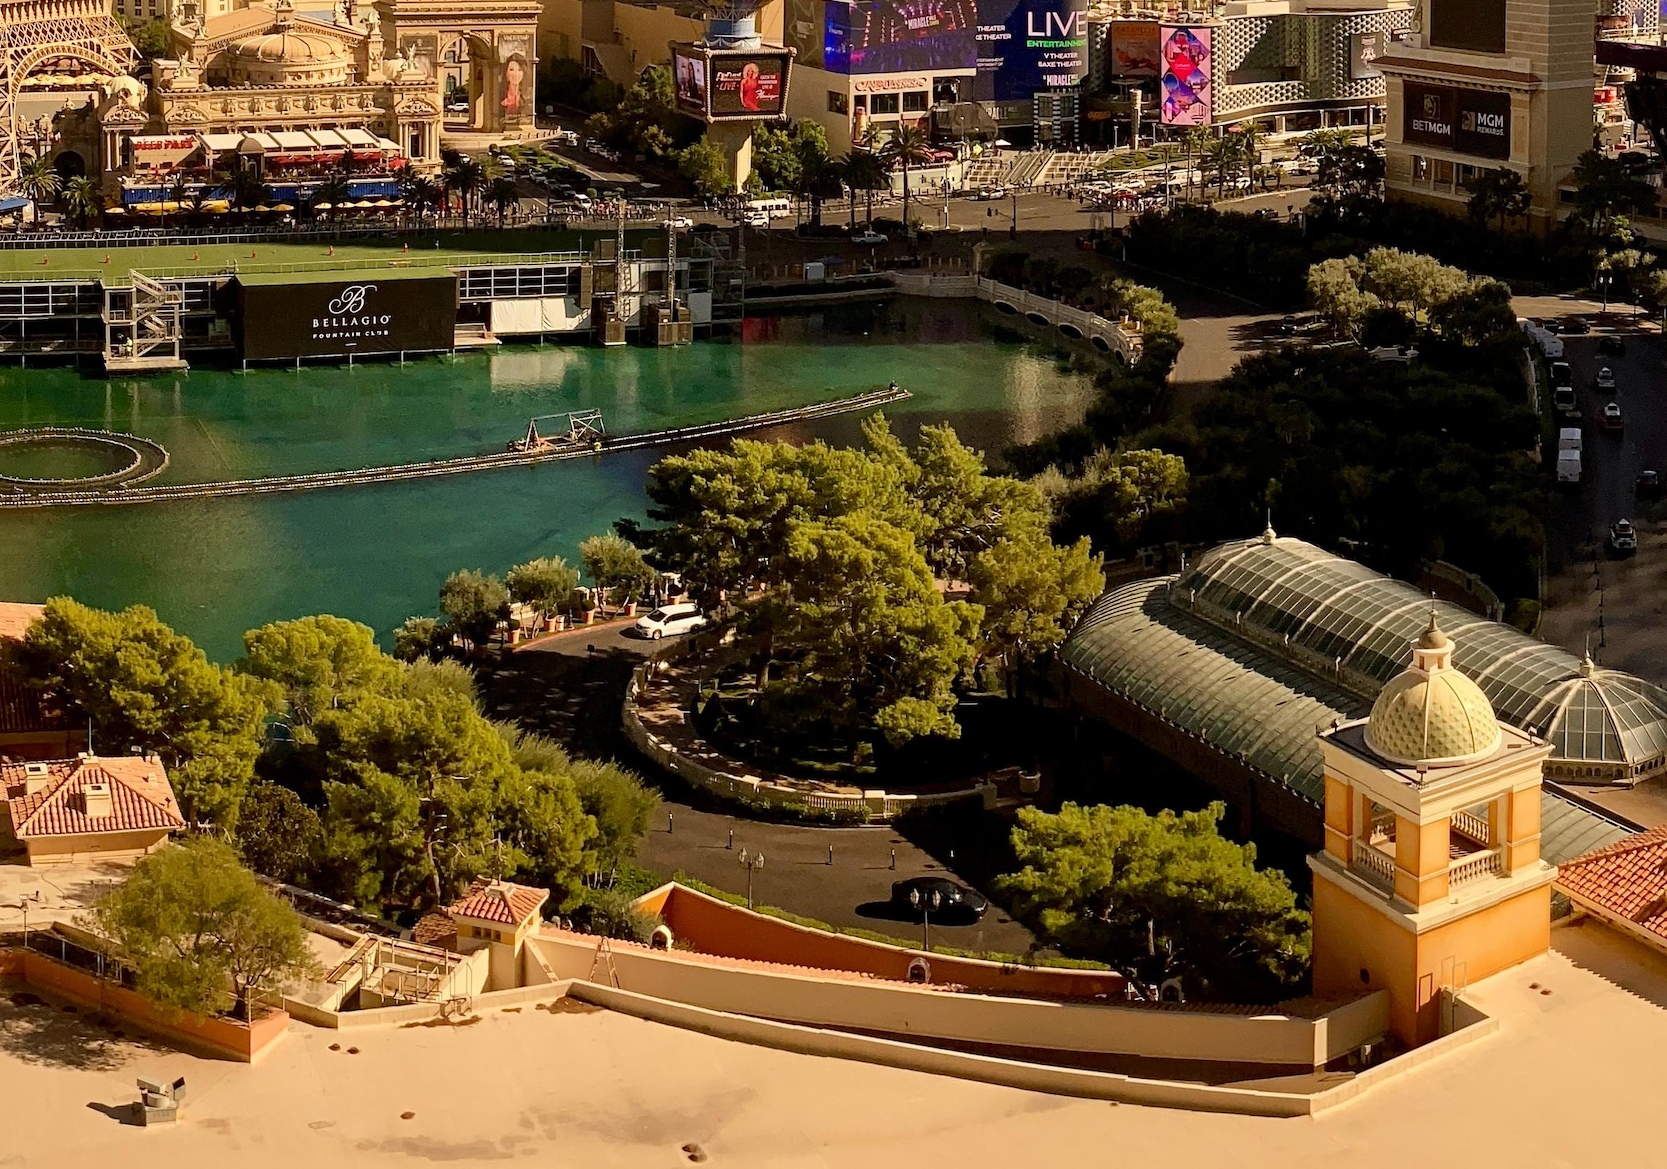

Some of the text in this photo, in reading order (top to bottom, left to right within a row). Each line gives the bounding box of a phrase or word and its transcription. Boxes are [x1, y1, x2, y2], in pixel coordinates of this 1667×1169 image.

[908, 16, 930, 30] MIRACLE
[1027, 11, 1087, 37] LIVE
[1027, 39, 1087, 48] ENTERTAINM
[1047, 74, 1072, 86] MIRACLE
[1477, 112, 1504, 127] MGM
[1412, 119, 1451, 135] BETMGM
[328, 284, 378, 315] B
[312, 315, 390, 328] BELLAGIO
